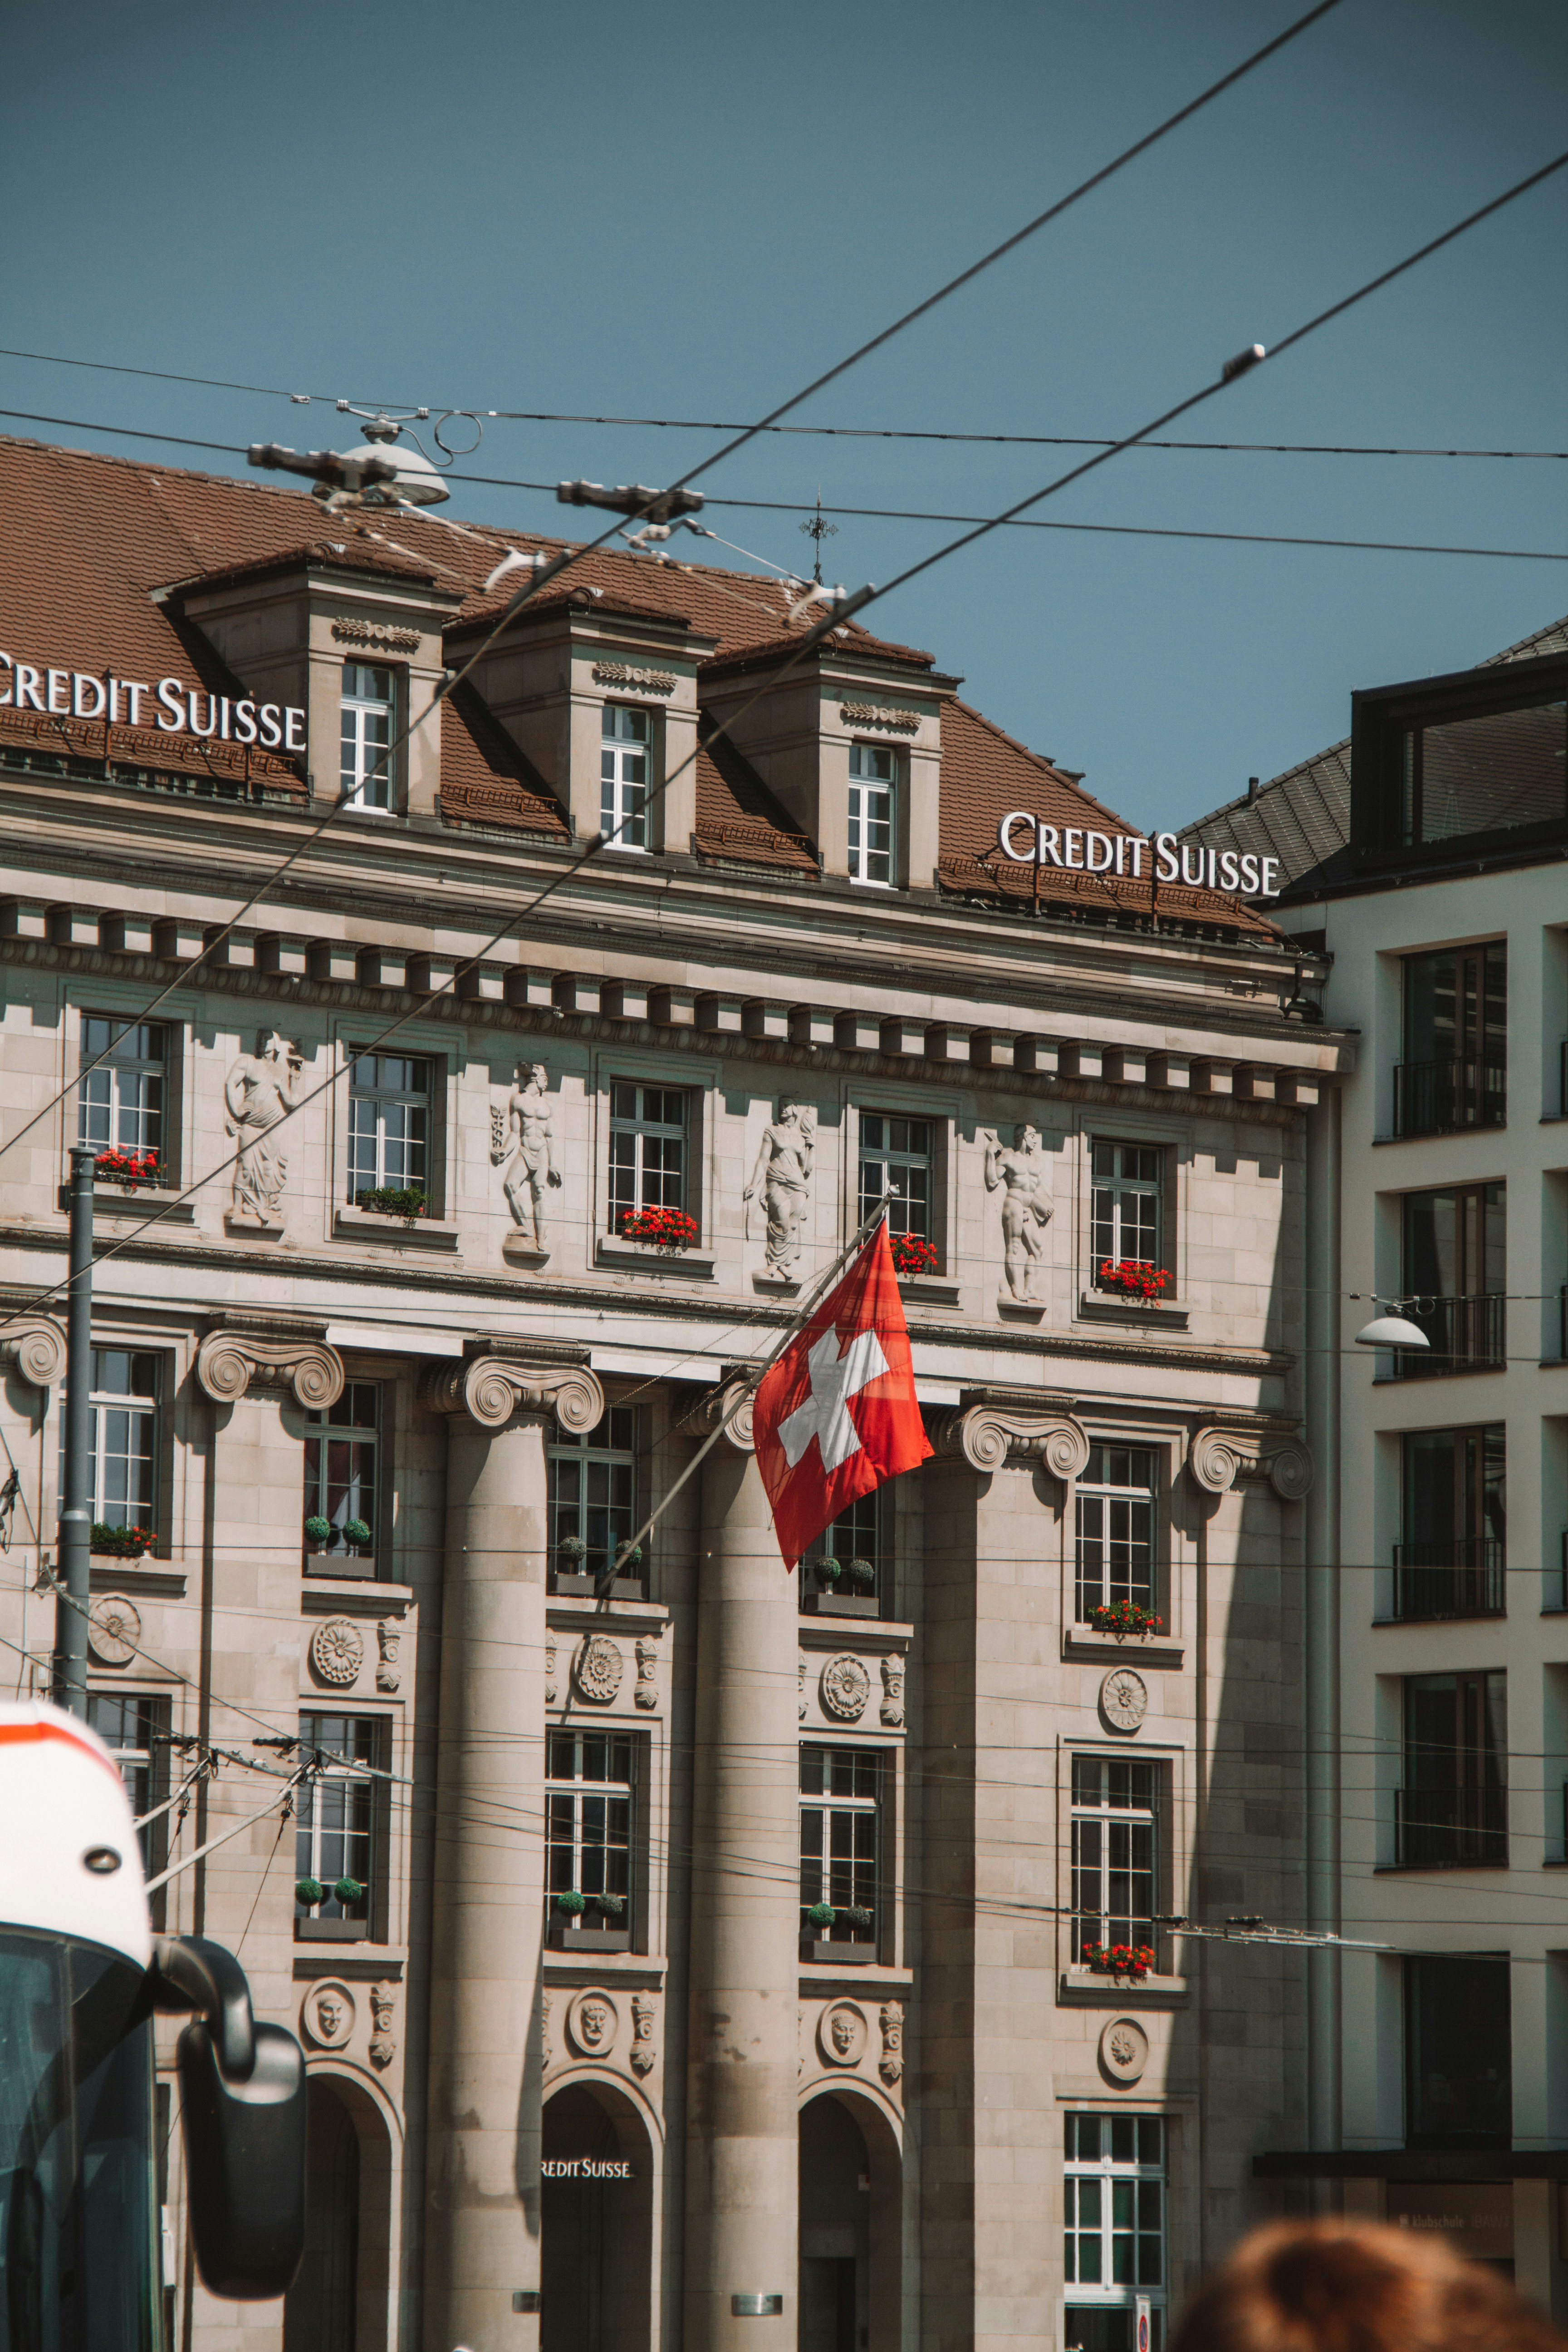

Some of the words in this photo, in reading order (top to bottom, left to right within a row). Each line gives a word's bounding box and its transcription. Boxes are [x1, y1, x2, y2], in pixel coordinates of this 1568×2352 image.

[0, 650, 149, 725] REDIT
[157, 677, 306, 751] SUISSE
[999, 811, 1149, 877] CREDIT
[1154, 833, 1281, 897] SUISSE
[541, 2161, 581, 2177] REDIT
[581, 2159, 630, 2178] SUISSE
